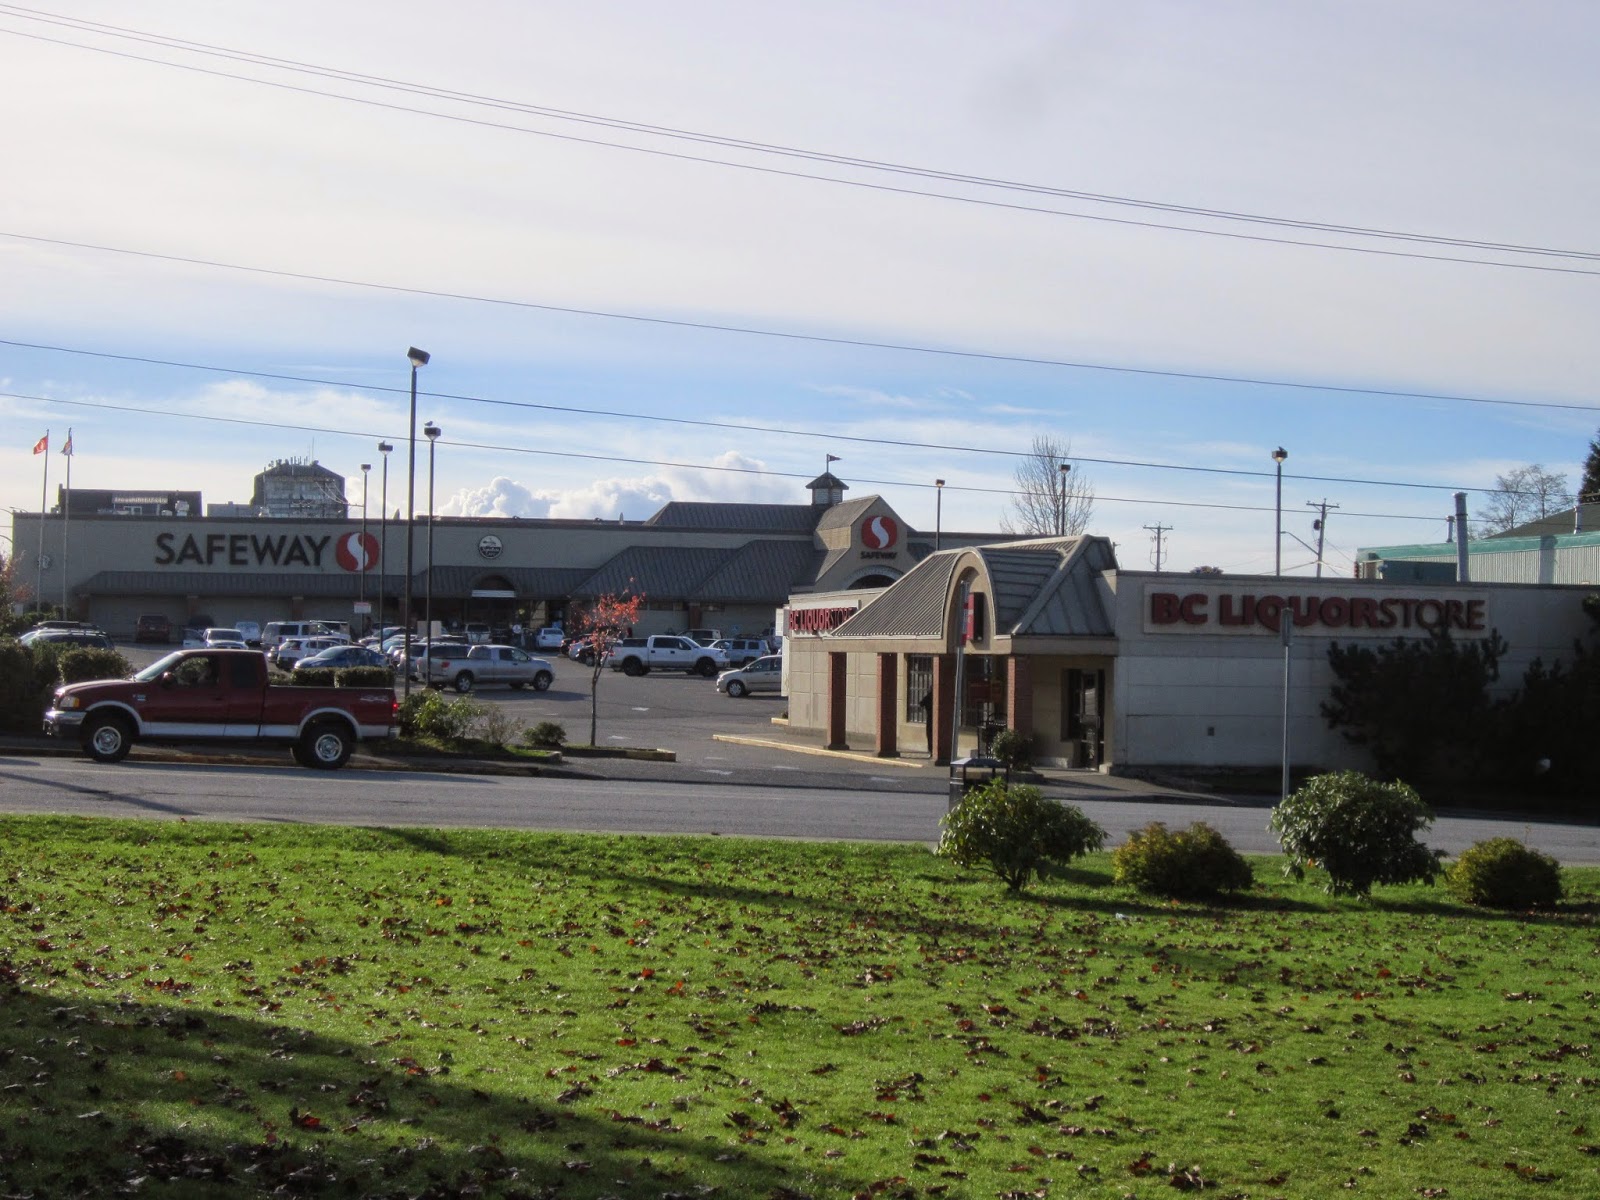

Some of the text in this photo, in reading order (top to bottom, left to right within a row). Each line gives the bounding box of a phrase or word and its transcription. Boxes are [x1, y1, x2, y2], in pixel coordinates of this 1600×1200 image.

[155, 532, 331, 566] SAFEWAY
[789, 609, 800, 631] BC
[1151, 592, 1208, 626] BC
